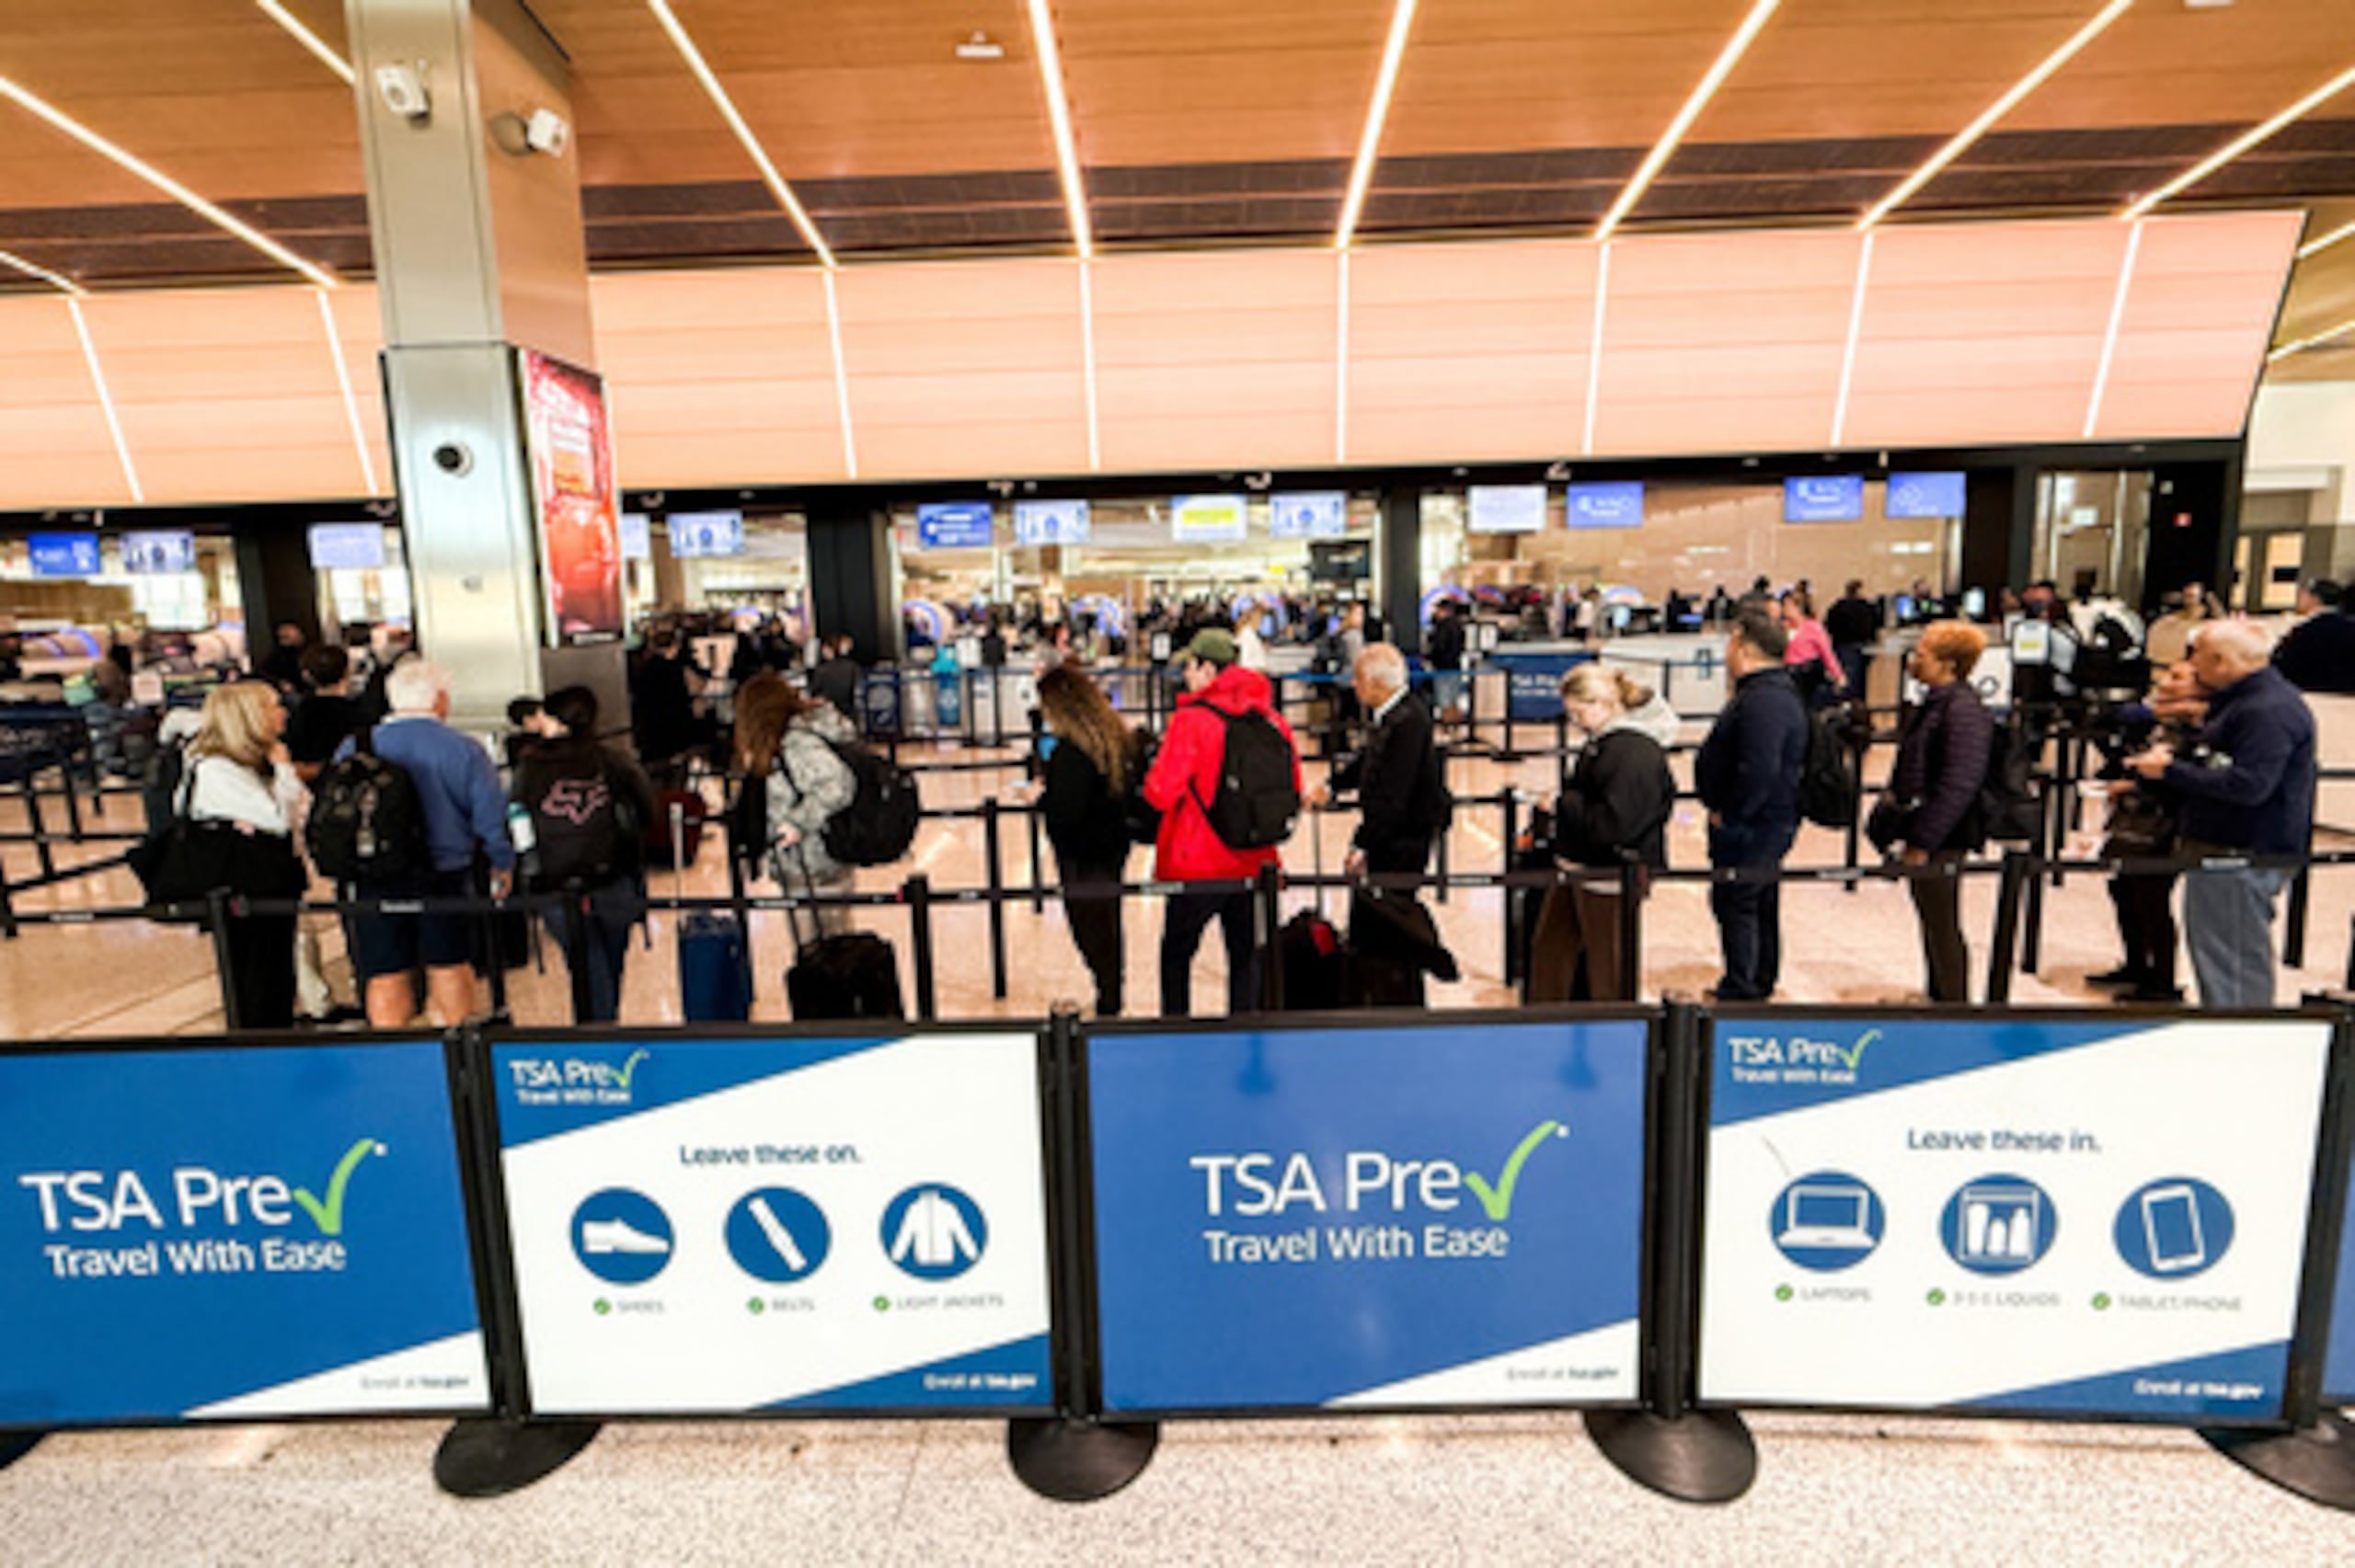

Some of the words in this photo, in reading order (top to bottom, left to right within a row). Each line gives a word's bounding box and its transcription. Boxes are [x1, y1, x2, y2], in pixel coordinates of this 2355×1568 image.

[1727, 1036, 1785, 1064] TSA
[1788, 1036, 1839, 1065] Pre
[509, 1059, 563, 1087] TSA
[564, 1059, 610, 1086] Pre
[679, 1144, 750, 1168] Leave
[753, 1143, 821, 1165] these
[823, 1143, 863, 1164] on.
[1907, 1128, 1987, 1151] Leave
[1991, 1129, 2064, 1152] these
[2068, 1129, 2103, 1153] in.
[17, 1169, 165, 1231] TSA
[173, 1166, 293, 1227] Pre
[1189, 1153, 1328, 1216] TSA
[1345, 1151, 1462, 1212] Pre
[43, 1241, 159, 1277] Travel
[164, 1238, 256, 1275] With
[260, 1237, 347, 1272] Ease
[1202, 1228, 1317, 1263] Travel
[1327, 1224, 1415, 1258] With
[1423, 1224, 1511, 1256] Ease
